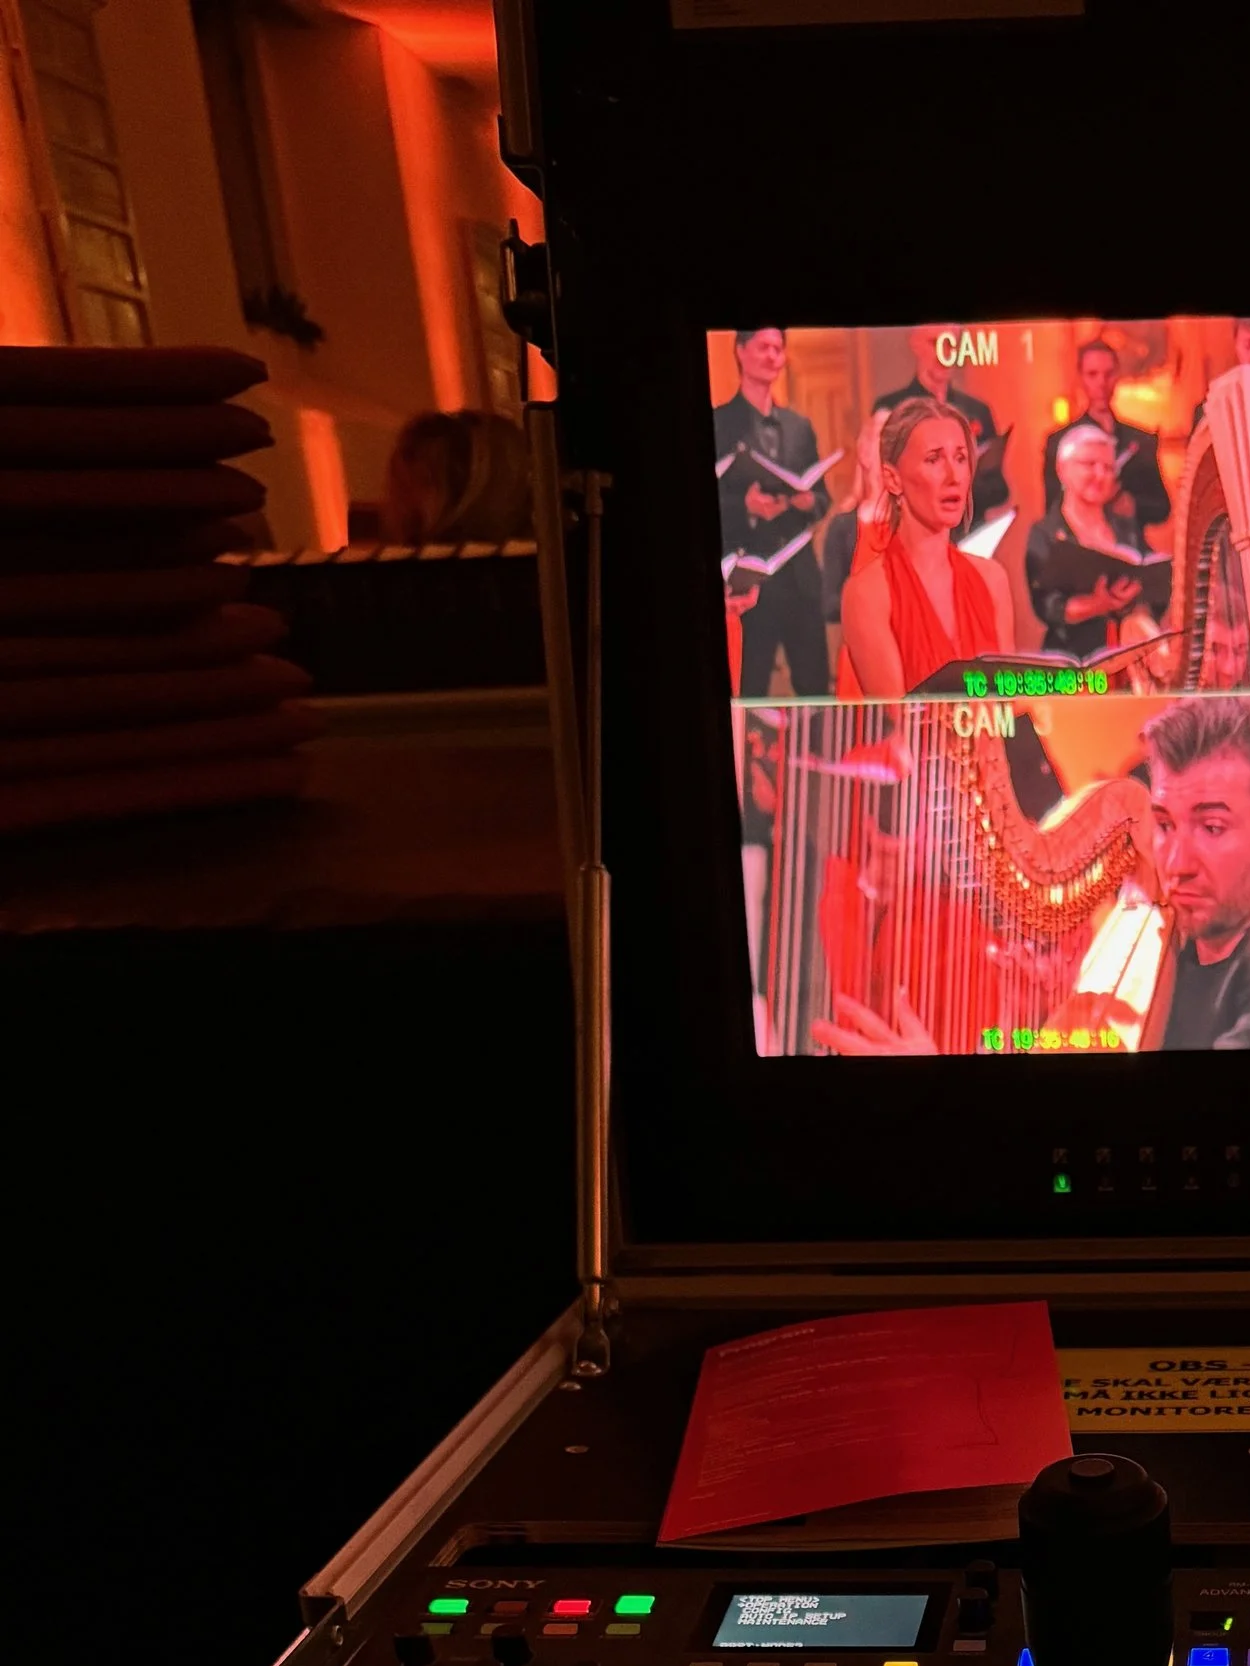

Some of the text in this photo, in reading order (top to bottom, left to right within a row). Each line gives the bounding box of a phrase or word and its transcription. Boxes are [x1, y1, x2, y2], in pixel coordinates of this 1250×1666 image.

[936, 331, 1034, 368] CAM 1
[963, 671, 987, 697] TC
[953, 704, 1015, 738] CAM
[1150, 1361, 1228, 1371] OBS
[1091, 1378, 1170, 1388] SKAL
[1121, 1389, 1198, 1400] IKKE
[445, 1579, 545, 1590] SONY
